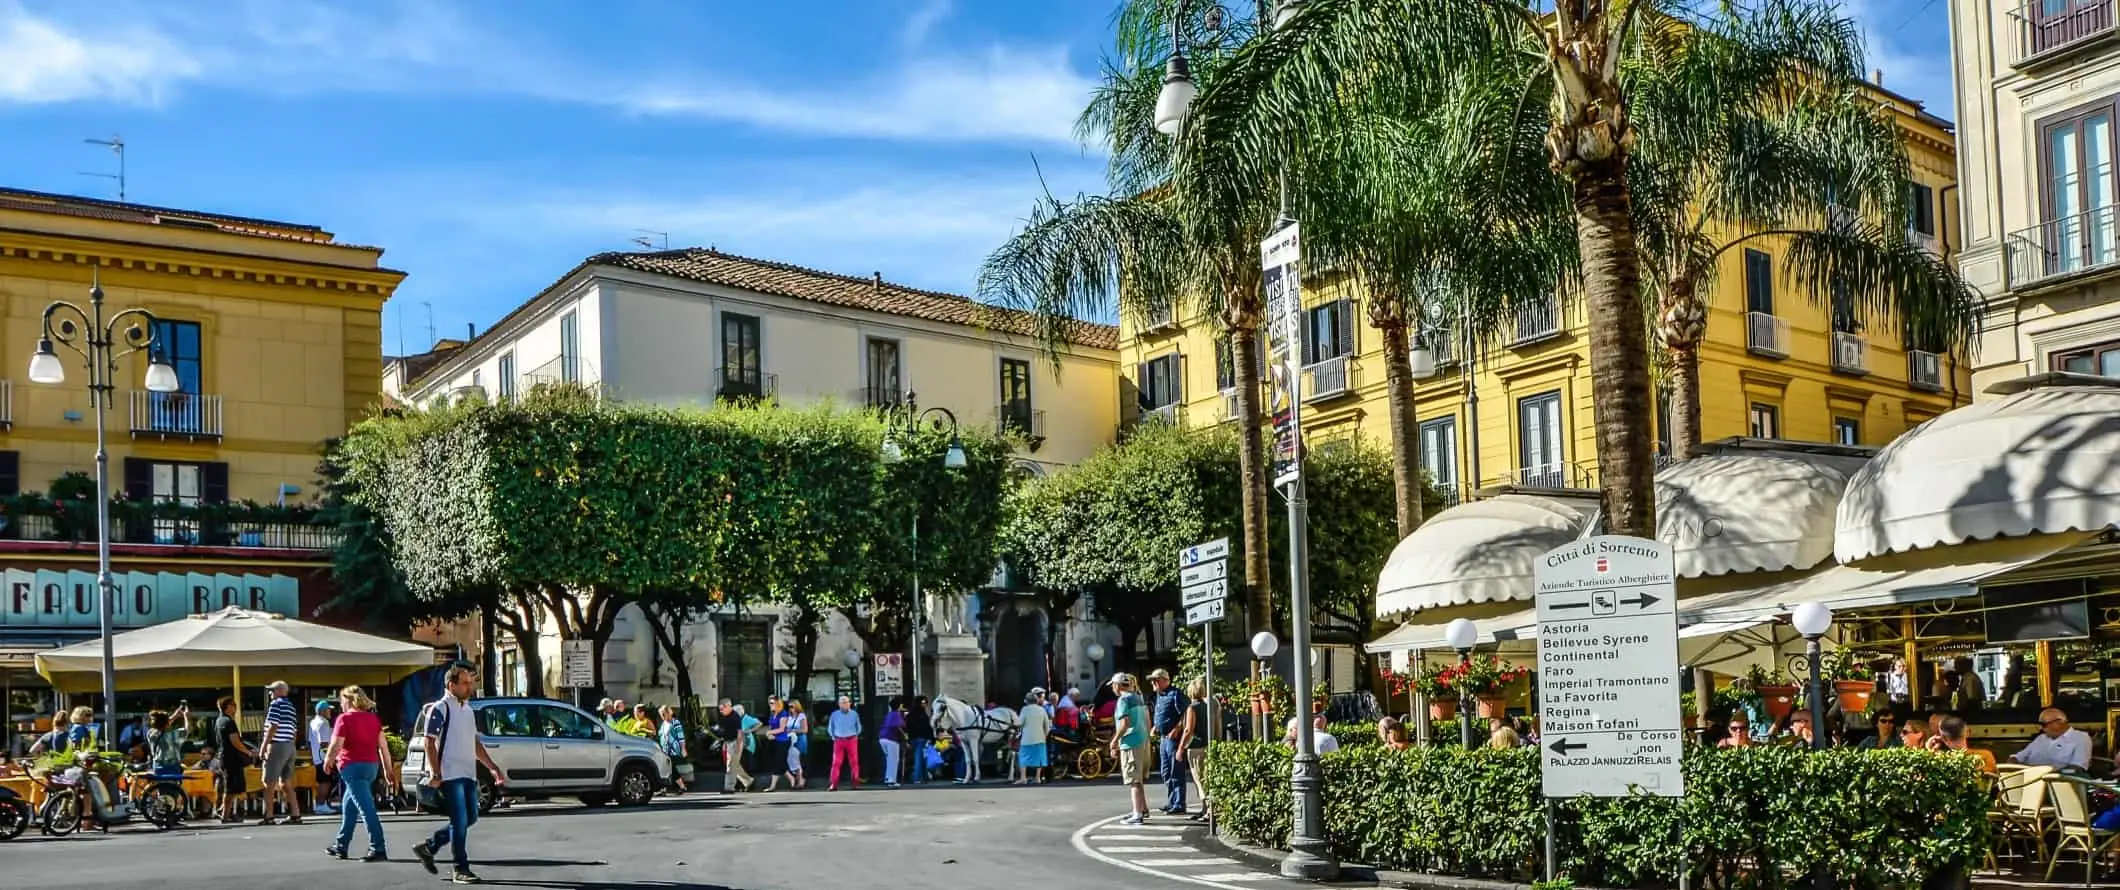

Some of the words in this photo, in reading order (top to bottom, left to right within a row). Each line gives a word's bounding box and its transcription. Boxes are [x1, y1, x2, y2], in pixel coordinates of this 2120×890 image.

[1582, 544, 1596, 556] di
[1600, 542, 1659, 560] Sorrento
[1540, 580, 1574, 590] Aziende
[1578, 577, 1616, 587] Turistico
[1618, 573, 1670, 586] Alberghiere
[13, 583, 152, 615] FAUNO
[193, 586, 266, 614] BAR
[1543, 624, 1589, 634] Astoria
[1544, 638, 1598, 648] Bellevue
[1603, 634, 1648, 646] Syrene
[1544, 650, 1618, 662] Continental
[1546, 666, 1574, 676] Faro
[1545, 678, 1592, 690] Imperial
[1596, 676, 1669, 686] Tramontano
[1546, 692, 1560, 702] La
[1564, 692, 1618, 702] Favorita
[1546, 706, 1590, 718] Regina
[1546, 720, 1594, 730] Maison
[1596, 718, 1638, 729] Tofani
[1618, 732, 1632, 740] De
[1640, 731, 1676, 740] Corso
[1550, 756, 1589, 766] PALAZZO
